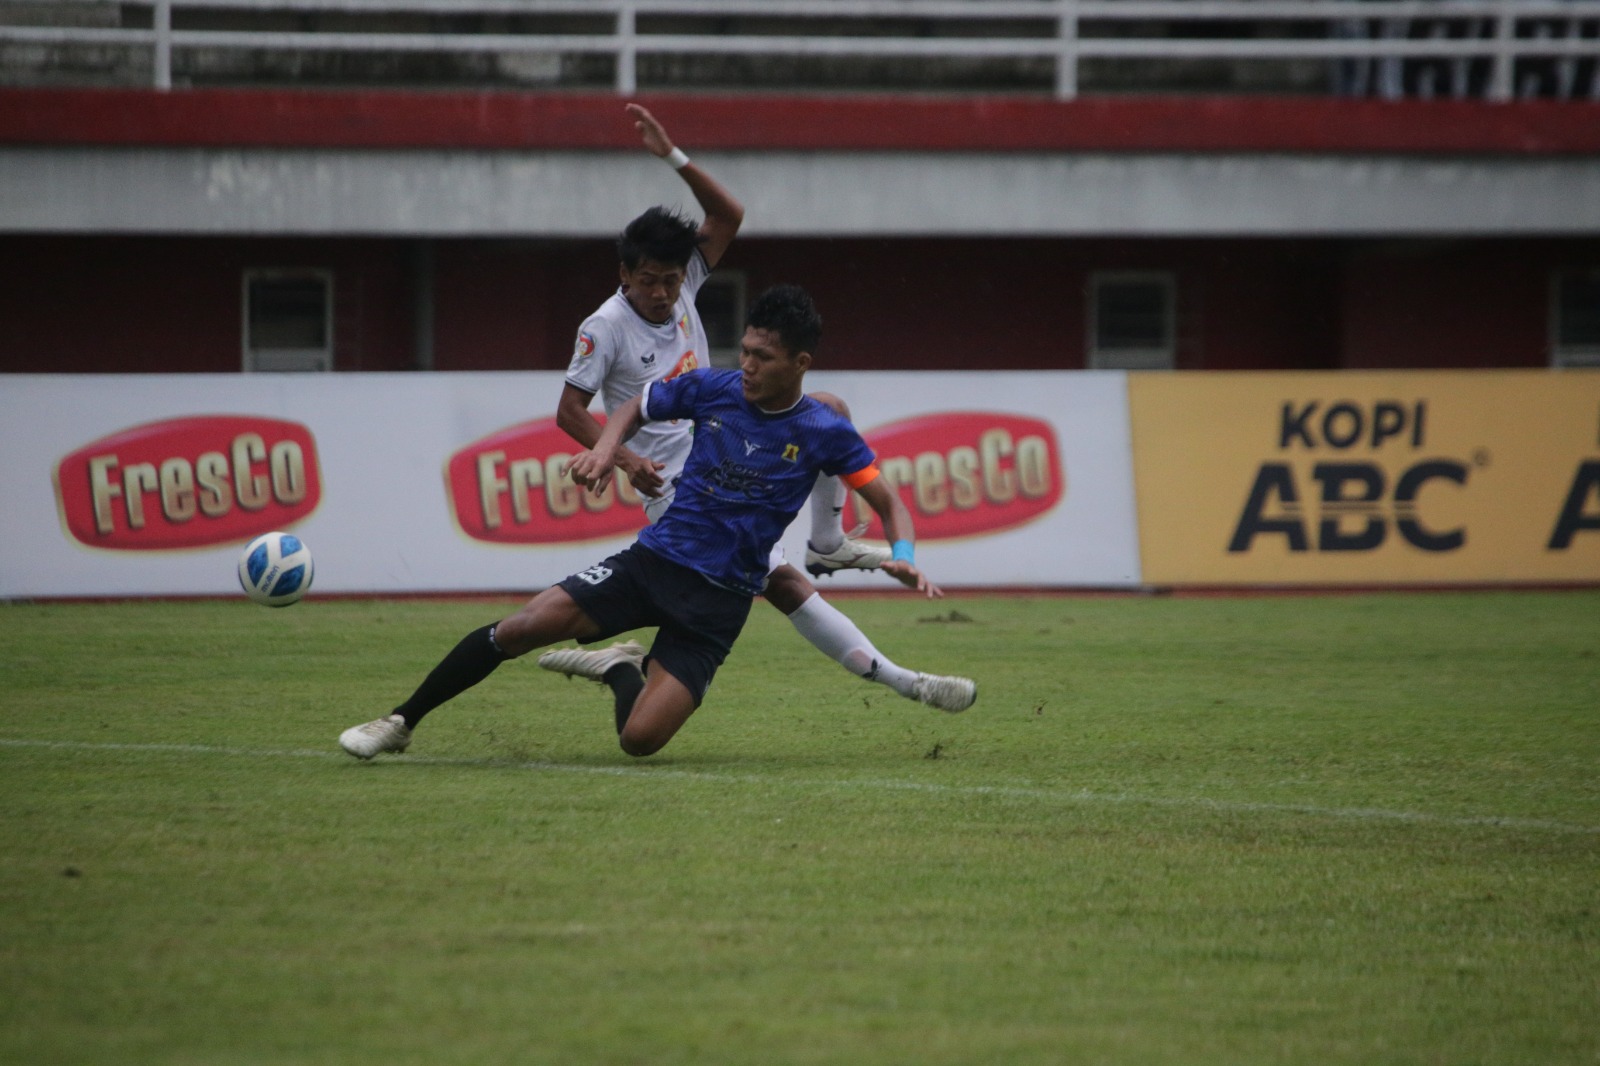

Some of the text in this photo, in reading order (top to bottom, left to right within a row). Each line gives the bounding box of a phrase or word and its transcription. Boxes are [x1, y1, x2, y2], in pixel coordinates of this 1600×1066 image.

[1279, 399, 1428, 449] KOPI
[88, 432, 305, 534] FresCo
[852, 428, 1049, 524] resCo
[1228, 460, 1468, 553] ABC
[262, 565, 280, 591] molten
[577, 566, 613, 585] 29
